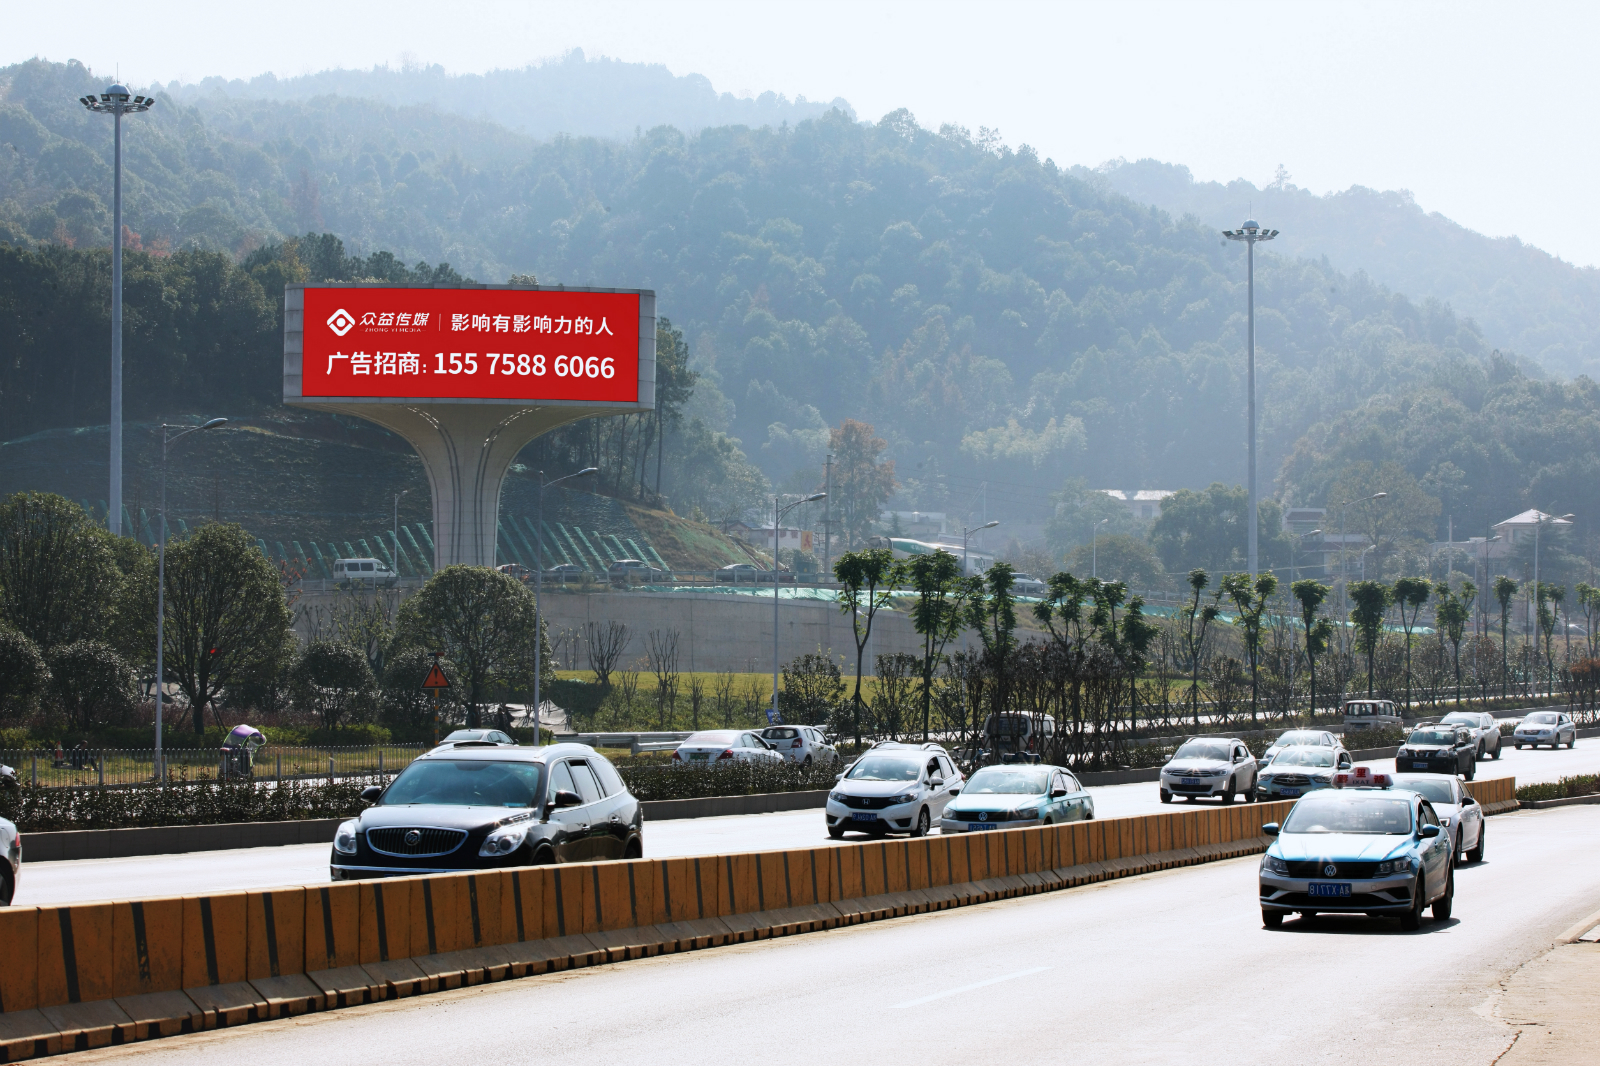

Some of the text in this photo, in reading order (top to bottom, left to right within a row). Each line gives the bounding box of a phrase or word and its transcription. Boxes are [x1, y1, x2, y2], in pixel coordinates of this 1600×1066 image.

[360, 312, 430, 327] 众益传媒
[451, 313, 614, 336] 影响有影响力的人
[434, 352, 478, 375] 155
[486, 353, 547, 377] 7588
[554, 354, 615, 379] 6066
